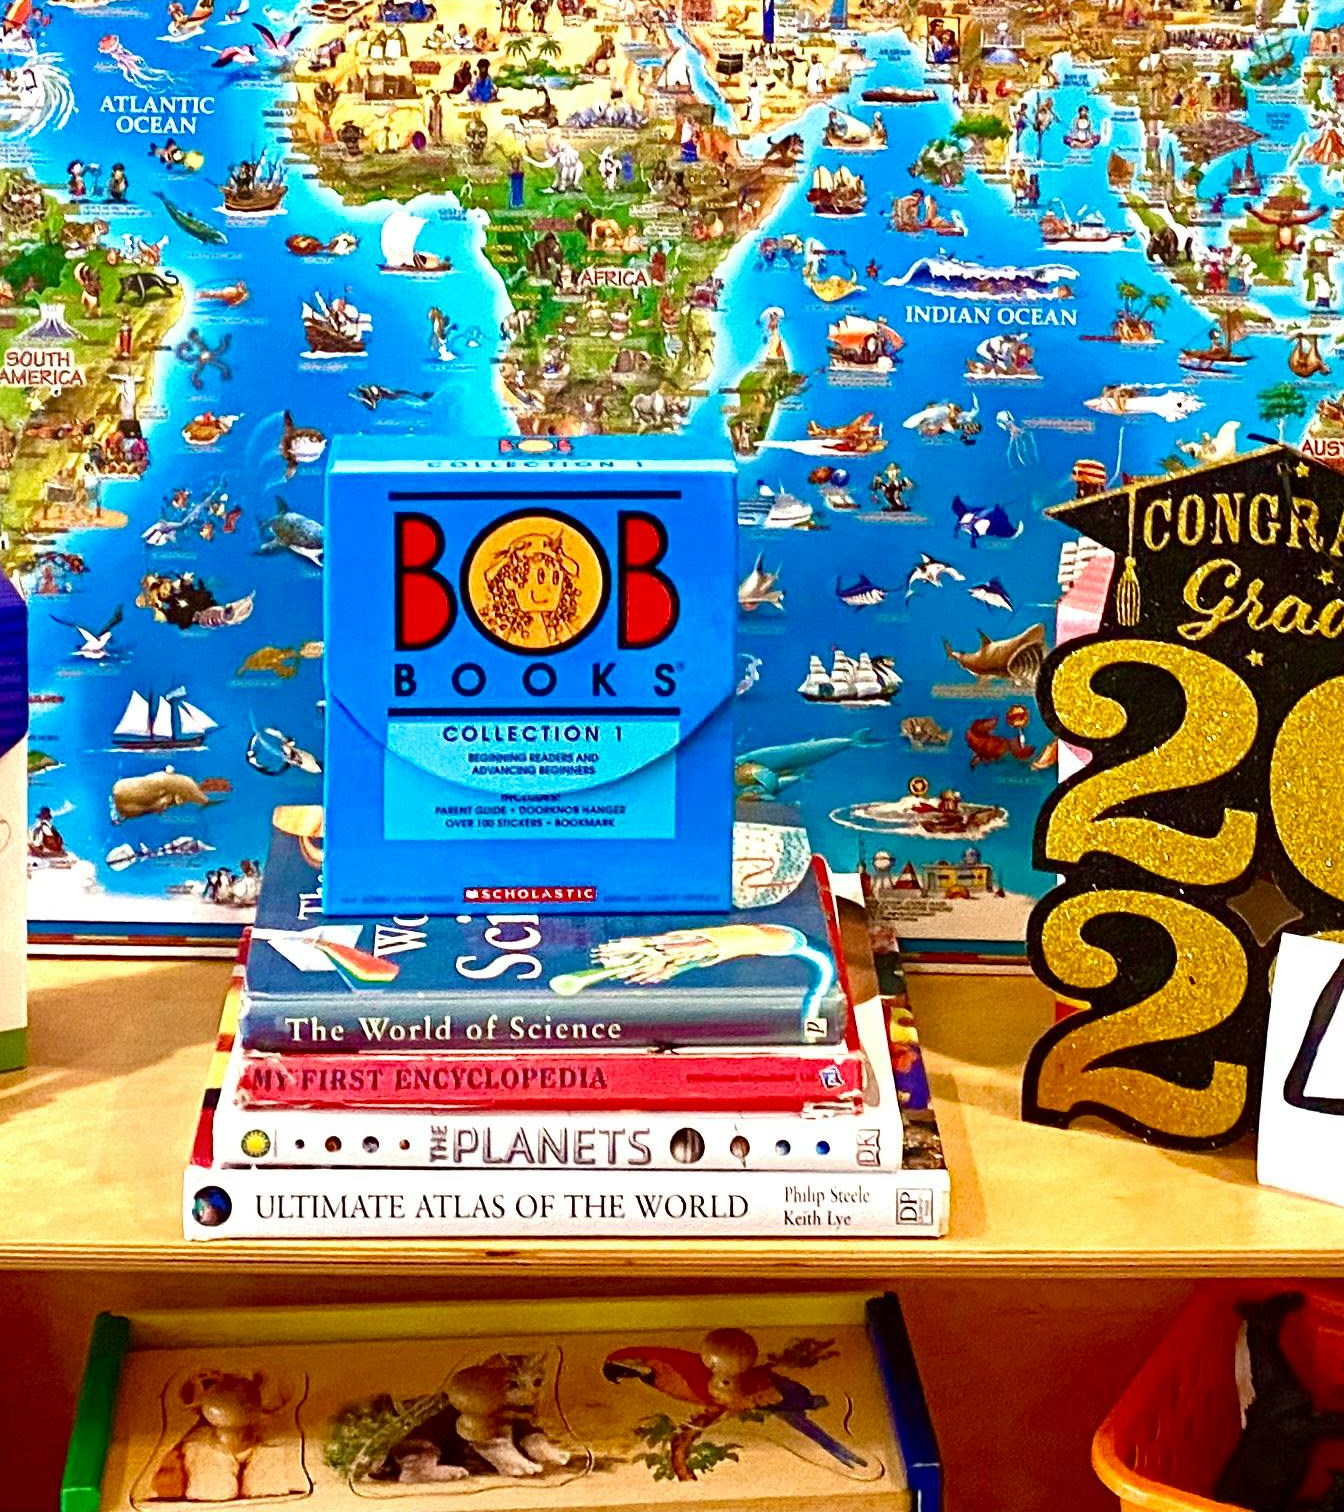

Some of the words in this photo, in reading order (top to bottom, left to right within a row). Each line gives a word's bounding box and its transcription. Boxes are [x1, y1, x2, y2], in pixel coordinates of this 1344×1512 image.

[99, 95, 216, 115] ATLANTIC
[115, 115, 197, 135] OCEAN
[580, 270, 648, 287] AFRICA
[905, 306, 992, 324] INDIAN
[997, 309, 1078, 327] OCEAN
[6, 350, 71, 368] SOUTH
[428, 461, 614, 469] COLLECTION
[394, 507, 681, 656] BOB
[394, 662, 678, 697] BOOKS
[443, 725, 600, 742] COLLECTION
[615, 725, 623, 742] 1
[468, 753, 527, 763] BEGINNING
[529, 753, 573, 763] READERS
[575, 753, 599, 763] AND
[471, 765, 536, 776] ADVANCING
[539, 765, 596, 776] BEGINNERS
[435, 806, 473, 815] PARENT
[474, 806, 506, 815] GUIDE
[519, 805, 580, 815] DOORKNOB
[582, 805, 626, 815] HANGER
[445, 818, 474, 828] OVER
[477, 818, 495, 828] 100
[497, 818, 542, 828] STICKERS
[554, 818, 615, 828] BOOKMARK
[481, 888, 594, 900] SCHOLASTIC
[285, 1017, 344, 1041] The
[359, 1015, 451, 1041] World
[466, 1014, 498, 1040] of
[510, 1015, 623, 1040] Science
[255, 1068, 291, 1091] MY
[305, 1068, 384, 1091] FIRST
[395, 1067, 607, 1091] ENCYCLOPEDIA
[430, 1125, 448, 1162] THE
[452, 1128, 652, 1165] PLANETS
[256, 1194, 405, 1219] ULTIMATE
[416, 1194, 506, 1219] ATLAS
[515, 1194, 556, 1219] OF
[564, 1194, 626, 1219] THE
[635, 1194, 750, 1219] WORLD
[785, 1185, 826, 1208] Philip
[830, 1185, 870, 1204] Steele
[899, 1191, 918, 1222] DP
[783, 1210, 821, 1226] Keith
[827, 1210, 852, 1230] Lye
